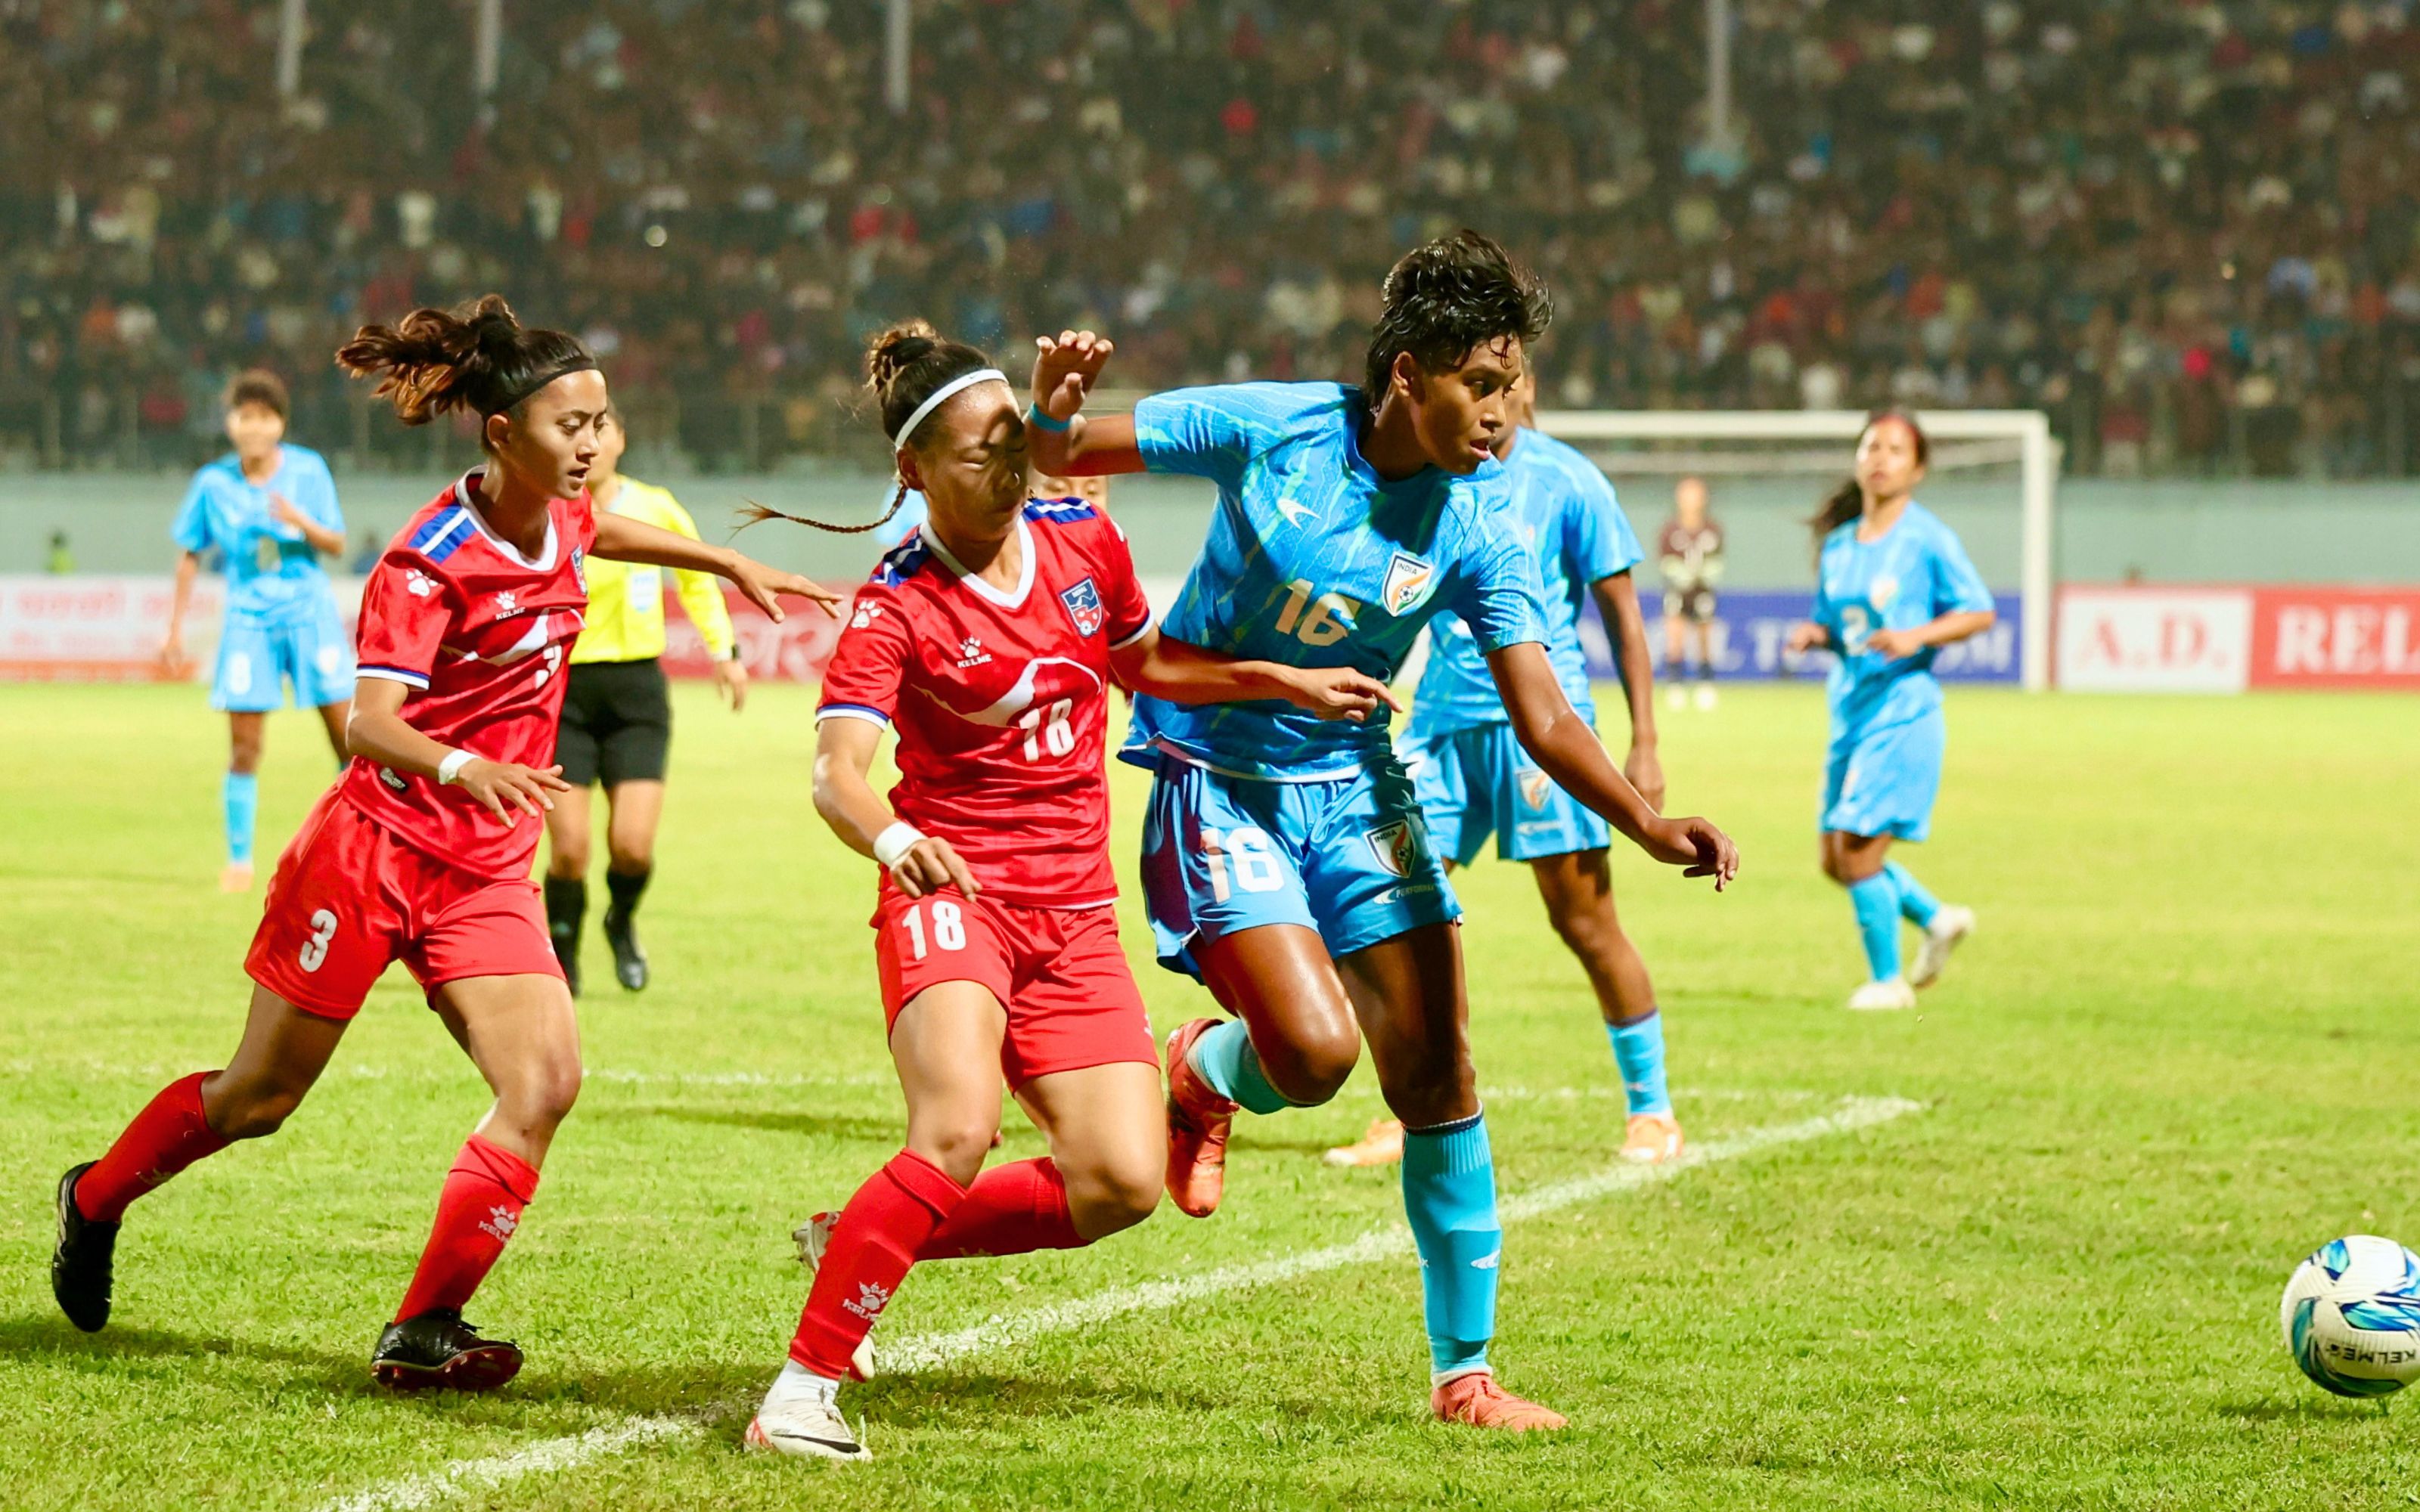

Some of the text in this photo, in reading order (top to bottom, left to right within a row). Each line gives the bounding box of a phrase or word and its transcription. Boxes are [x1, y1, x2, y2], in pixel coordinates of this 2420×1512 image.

[1397, 562, 1417, 575] INDIA
[495, 606, 526, 620] KELME
[1274, 578, 1360, 646] 16
[957, 653, 992, 668] KELME
[1019, 698, 1075, 762] 18
[1374, 829, 1398, 842] INDIA
[1201, 826, 1285, 904] 16
[299, 909, 337, 972] 3
[901, 900, 966, 961] 18
[2343, 1348, 2416, 1364] KELME
